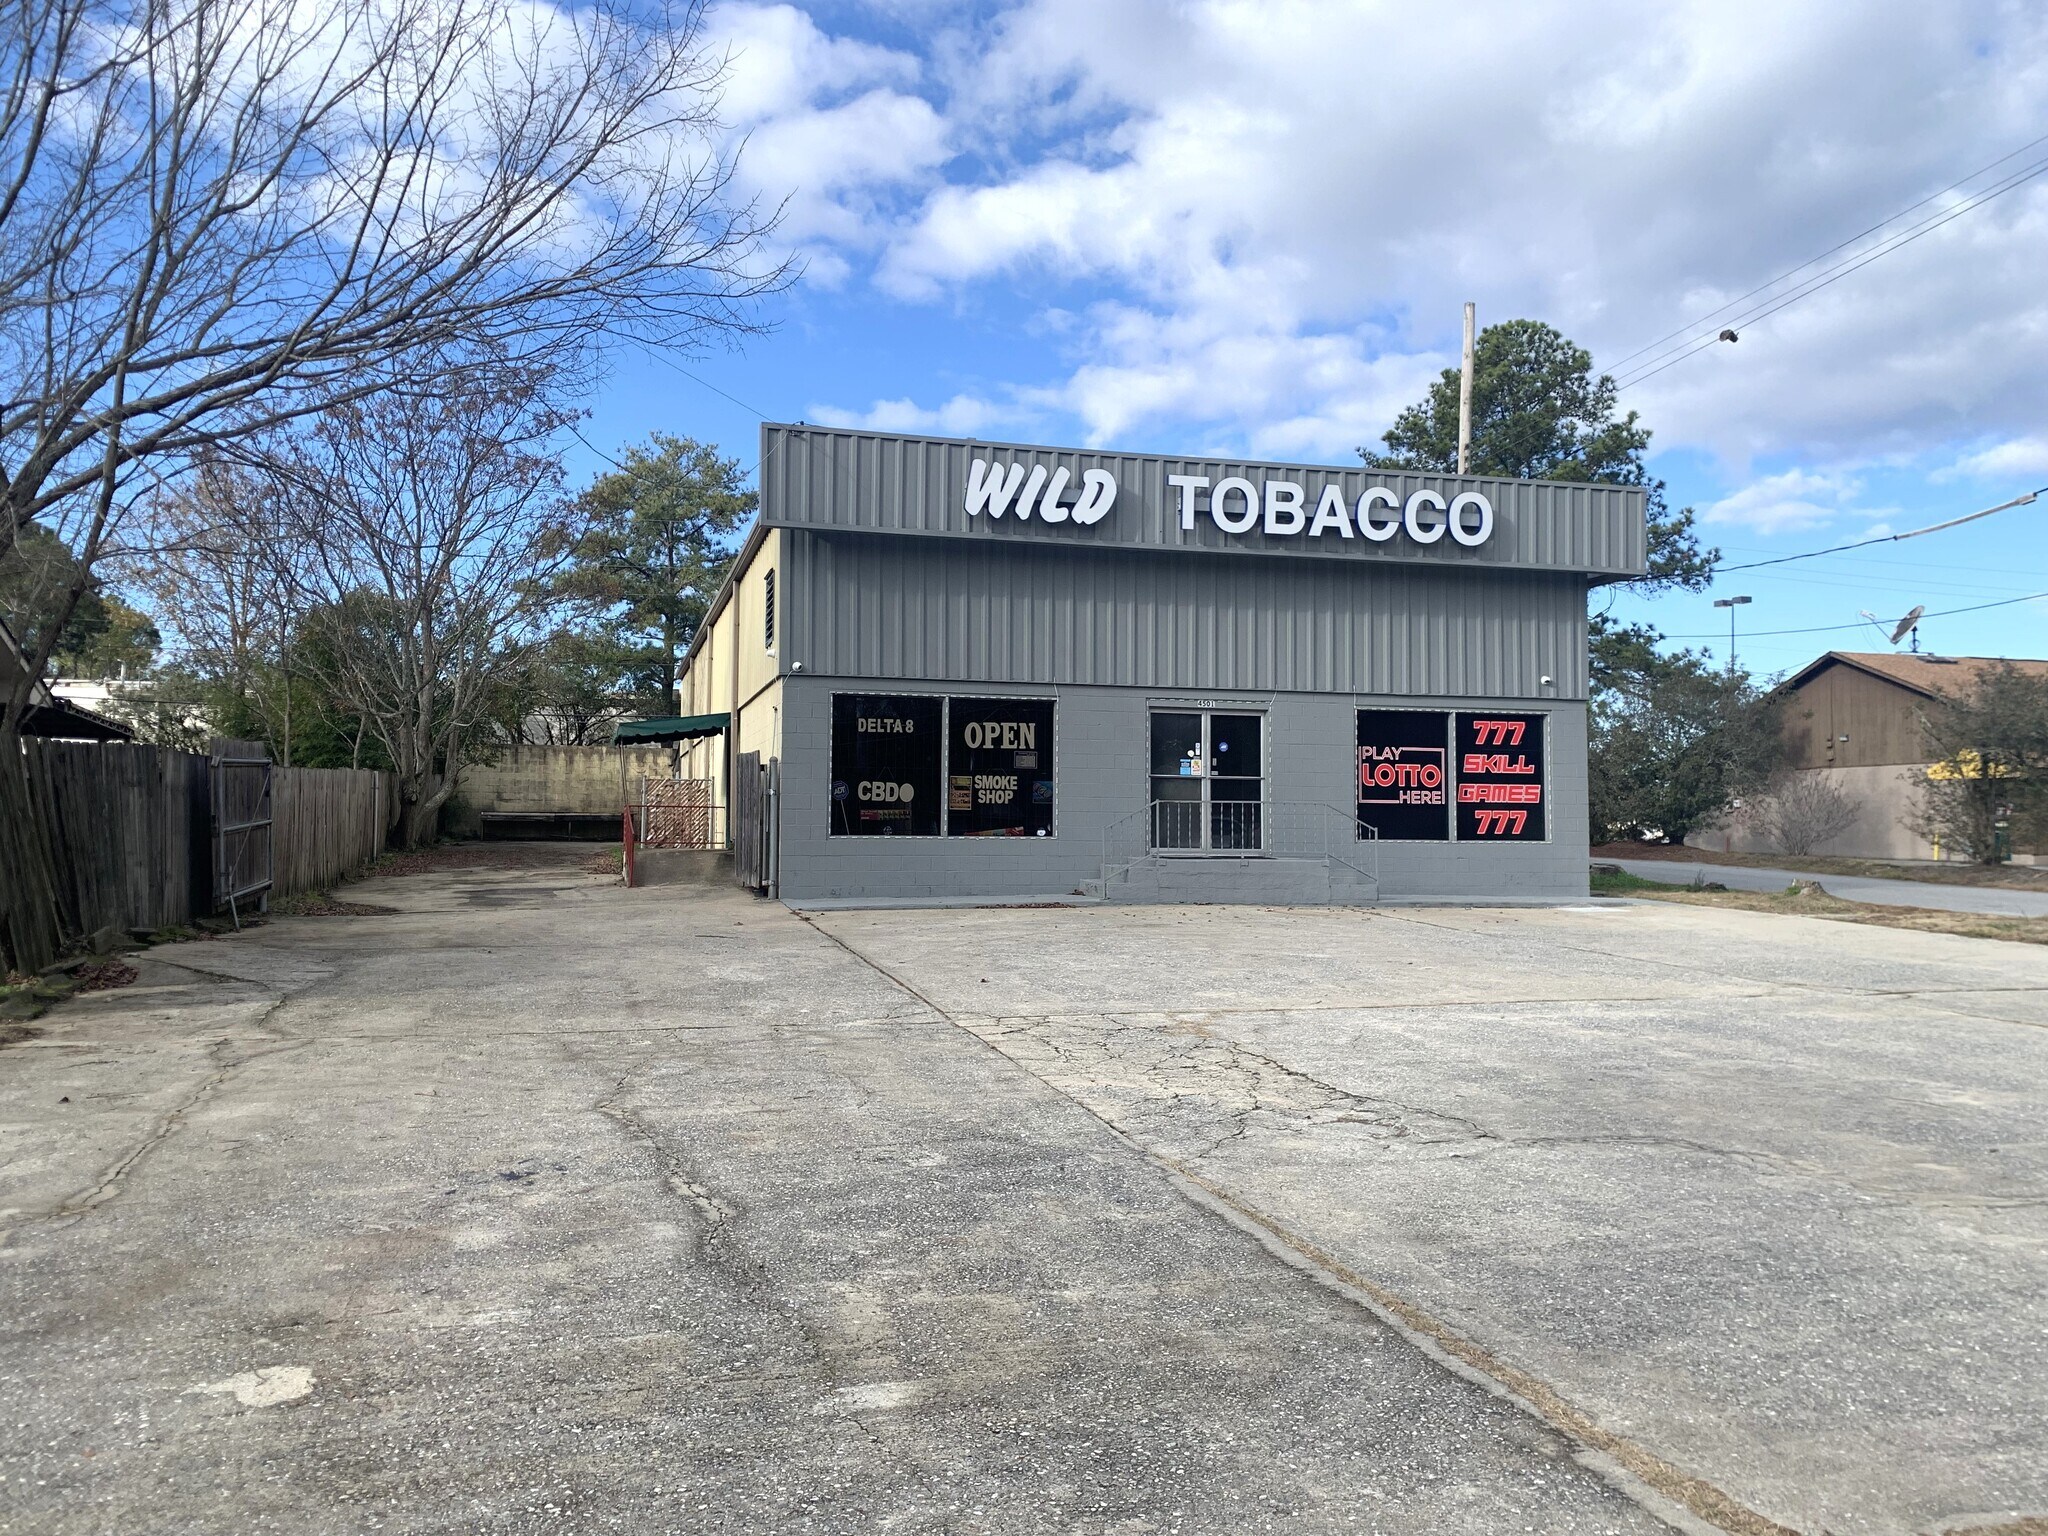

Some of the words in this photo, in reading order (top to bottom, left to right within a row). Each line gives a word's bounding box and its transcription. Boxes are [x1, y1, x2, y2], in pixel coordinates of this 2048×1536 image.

[963, 458, 1118, 525] WILD
[1168, 474, 1494, 546] TOBACCO
[857, 718, 903, 733] DELTA
[905, 719, 914, 733] 8
[964, 722, 1036, 750] OPEN
[1473, 720, 1526, 746] 777
[1362, 746, 1403, 760] PLAY
[1463, 753, 1535, 774] SKILL
[974, 775, 1018, 790] SMOKE
[1362, 763, 1441, 788] LOTTO
[978, 790, 1014, 804] SHOP
[1399, 790, 1442, 805] HERE
[1457, 783, 1541, 804] GAMES
[1475, 810, 1527, 835] 777
